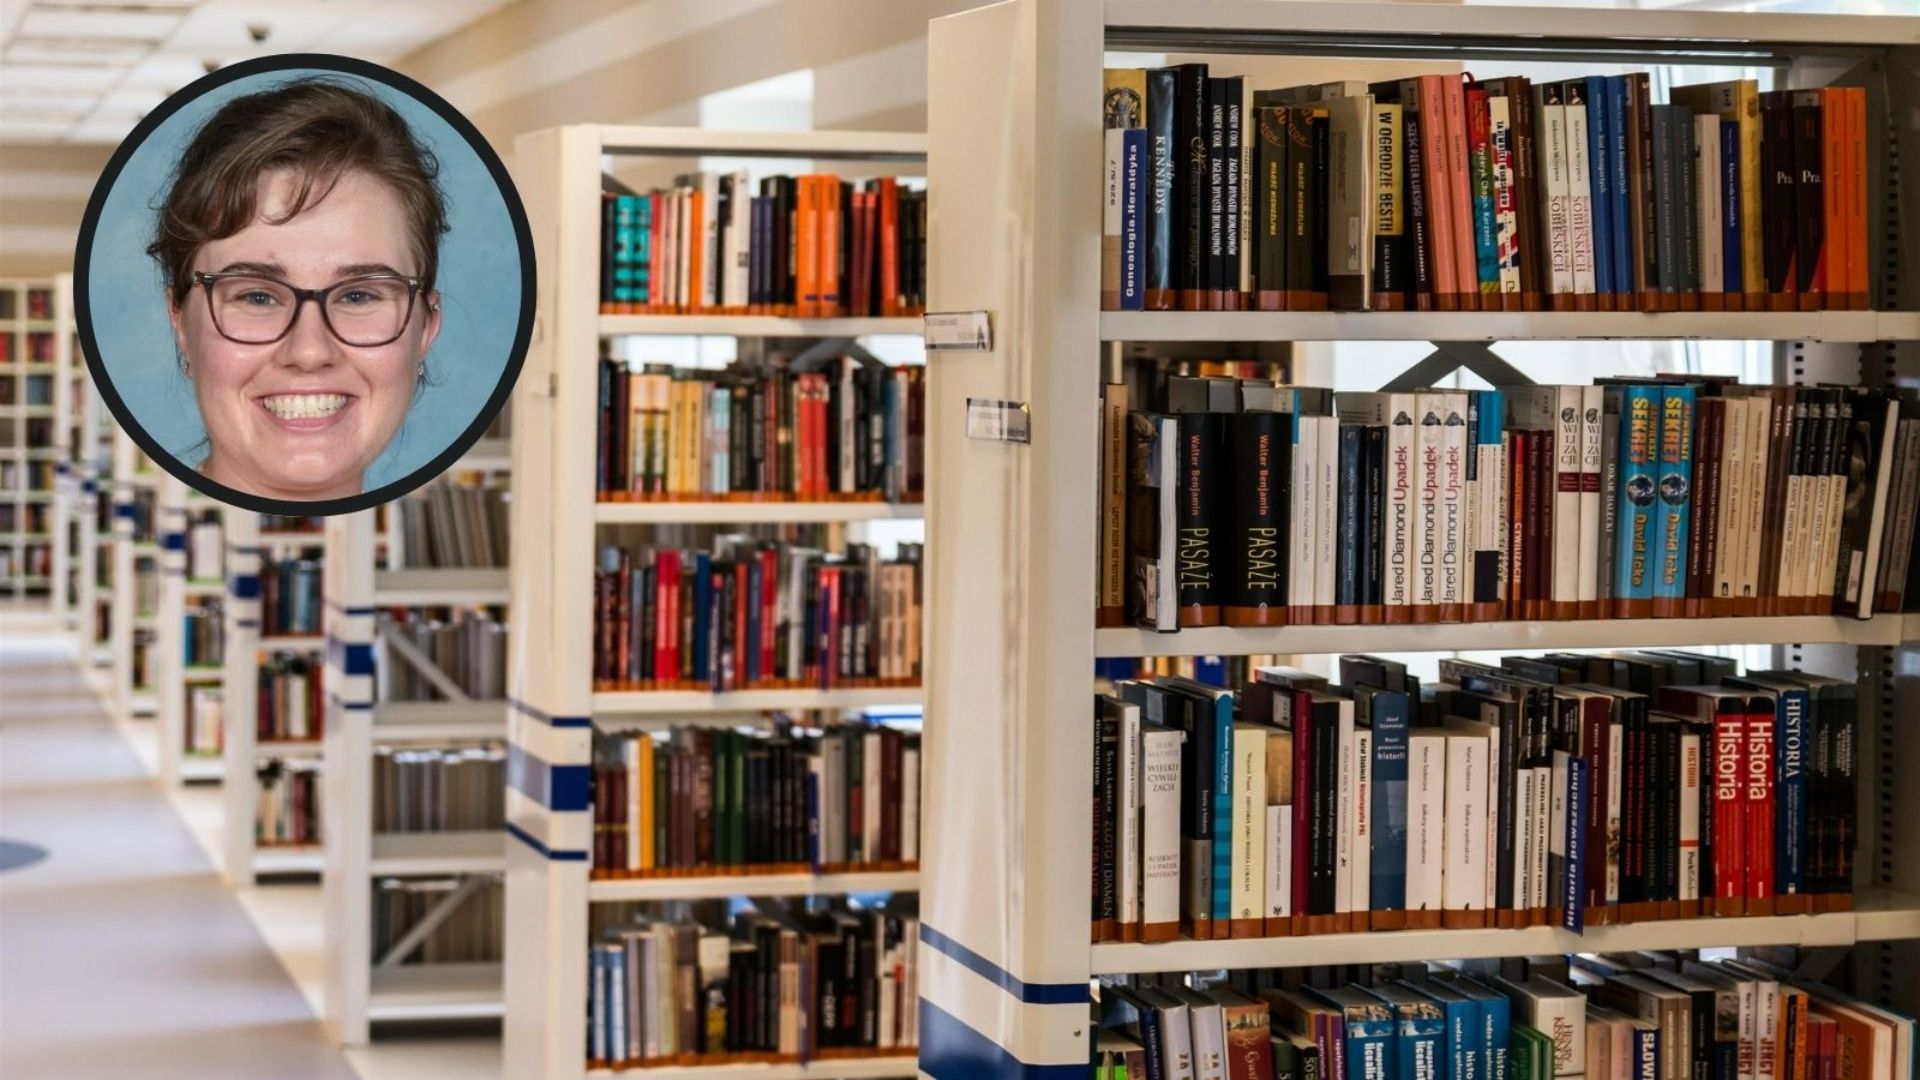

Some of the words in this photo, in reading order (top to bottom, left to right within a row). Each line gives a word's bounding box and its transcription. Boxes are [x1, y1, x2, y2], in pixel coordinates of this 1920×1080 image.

[1213, 104, 1222, 129] ANDREW
[1230, 104, 1239, 129] ANDREW
[1379, 112, 1392, 125] W
[1213, 130, 1222, 148] COOK
[1230, 130, 1239, 148] COOK
[1155, 135, 1166, 214] KENNEDYS
[1379, 127, 1393, 190] OGRODZIE
[1477, 142, 1488, 178] Fryderyk
[1125, 144, 1139, 298] Genealogia.Heraldyka
[1379, 193, 1393, 232] BESTII
[1481, 212, 1491, 247] Korzenie
[1550, 195, 1563, 273] SOBIESKICH
[1573, 195, 1586, 273] SOBIESKICH
[1630, 396, 1649, 465] SEKRET
[1663, 396, 1683, 465] SEKRET
[1191, 434, 1201, 467] Walter
[1259, 434, 1269, 467] Walter
[1561, 455, 1578, 465] CJE
[1585, 455, 1602, 466] CJE
[1189, 469, 1201, 516] Benjamin
[1257, 469, 1269, 516] Benjamin
[1392, 446, 1409, 501] Upadek
[1421, 446, 1438, 501] Upadek
[1444, 446, 1461, 501] Upadek
[1607, 463, 1616, 493] OSKAR
[1605, 494, 1615, 532] HALECKI
[1392, 503, 1406, 565] Diamond
[1421, 503, 1436, 565] Diamond
[1444, 503, 1458, 565] Diamond
[1633, 514, 1648, 552] David
[1665, 513, 1681, 552] David
[1181, 527, 1213, 590] PASAŻE
[1248, 527, 1280, 590] PASAŻE
[1513, 522, 1523, 585] CYWILIZACJE
[1631, 555, 1646, 587] Icke
[1663, 553, 1679, 585] Icke
[1392, 567, 1405, 605] Jared
[1421, 567, 1434, 605] Jared
[1443, 567, 1456, 605] Jared
[1359, 738, 1368, 754] Rafał
[1377, 752, 1406, 760] historii
[1785, 697, 1801, 779] HISTORIA
[1105, 750, 1114, 775] SILVIA
[1147, 763, 1180, 773] WIELKIE
[1687, 747, 1696, 788] HISTORIA
[1719, 721, 1743, 800] Historia
[1748, 721, 1773, 800] Historia
[1153, 783, 1176, 793] ZACJE
[1568, 762, 1580, 859] powszechna
[1566, 863, 1577, 927] Historia
[1455, 1017, 1464, 1043] wiedza
[1486, 1014, 1494, 1040] wiedza
[1560, 1024, 1574, 1063] HENRY
[1304, 1056, 1315, 1073] 50
